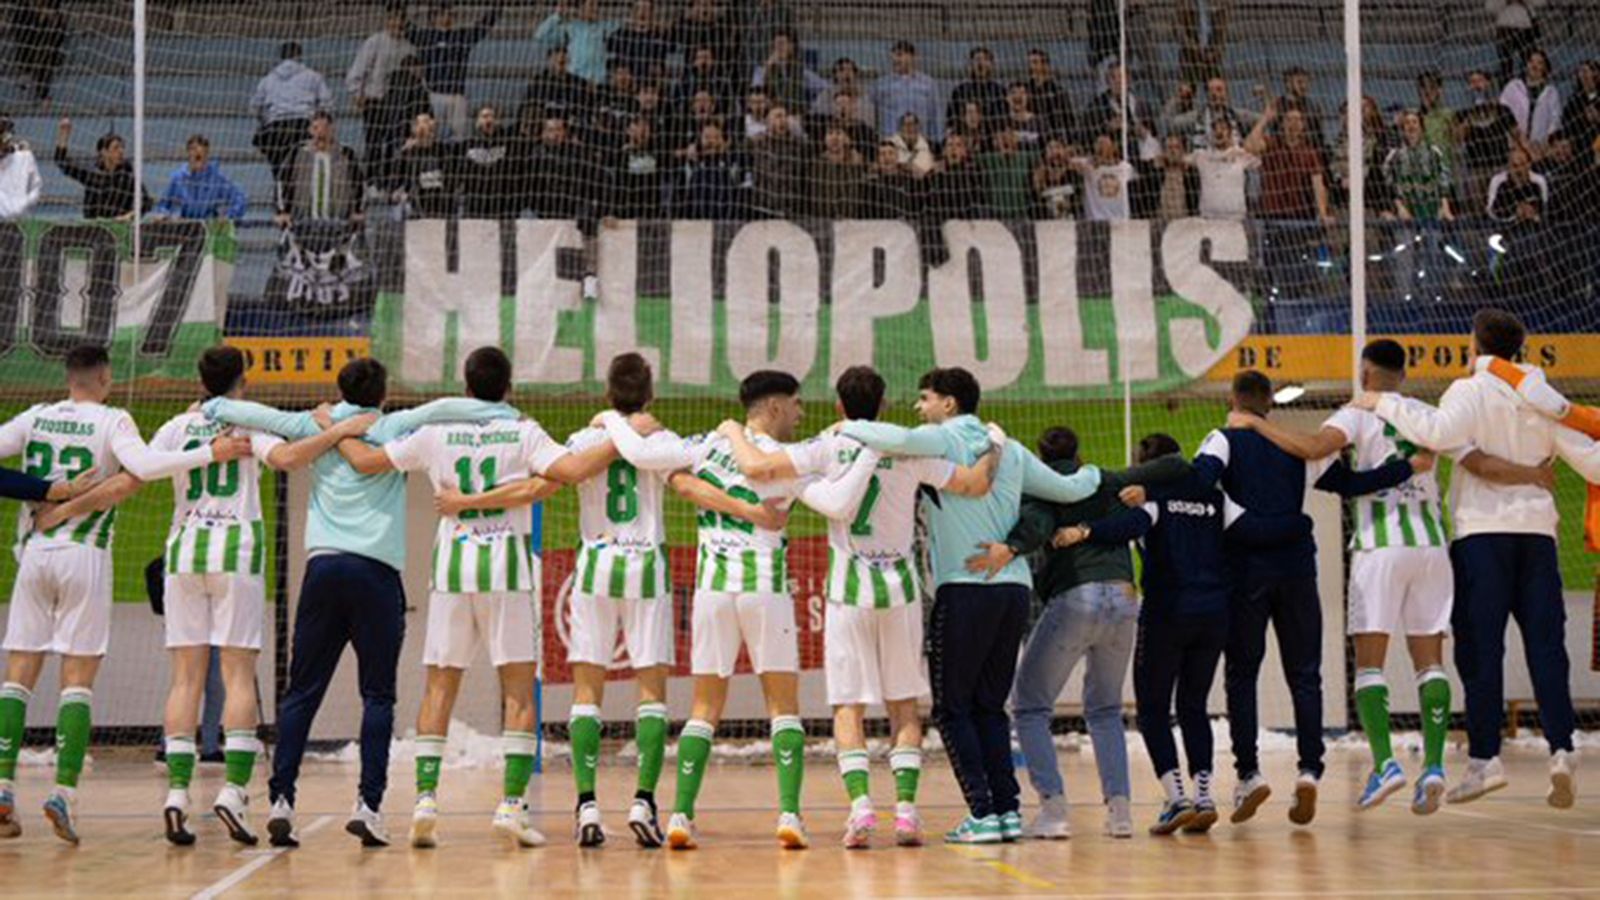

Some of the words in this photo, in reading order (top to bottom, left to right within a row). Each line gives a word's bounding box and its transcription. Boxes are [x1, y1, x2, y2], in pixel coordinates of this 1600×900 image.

[0, 217, 208, 358] 07
[401, 216, 1253, 391] HELIOPOLIS
[1239, 346, 1283, 369] DE
[183, 439, 240, 499] 10
[455, 456, 504, 520] 11
[606, 458, 638, 523] 8
